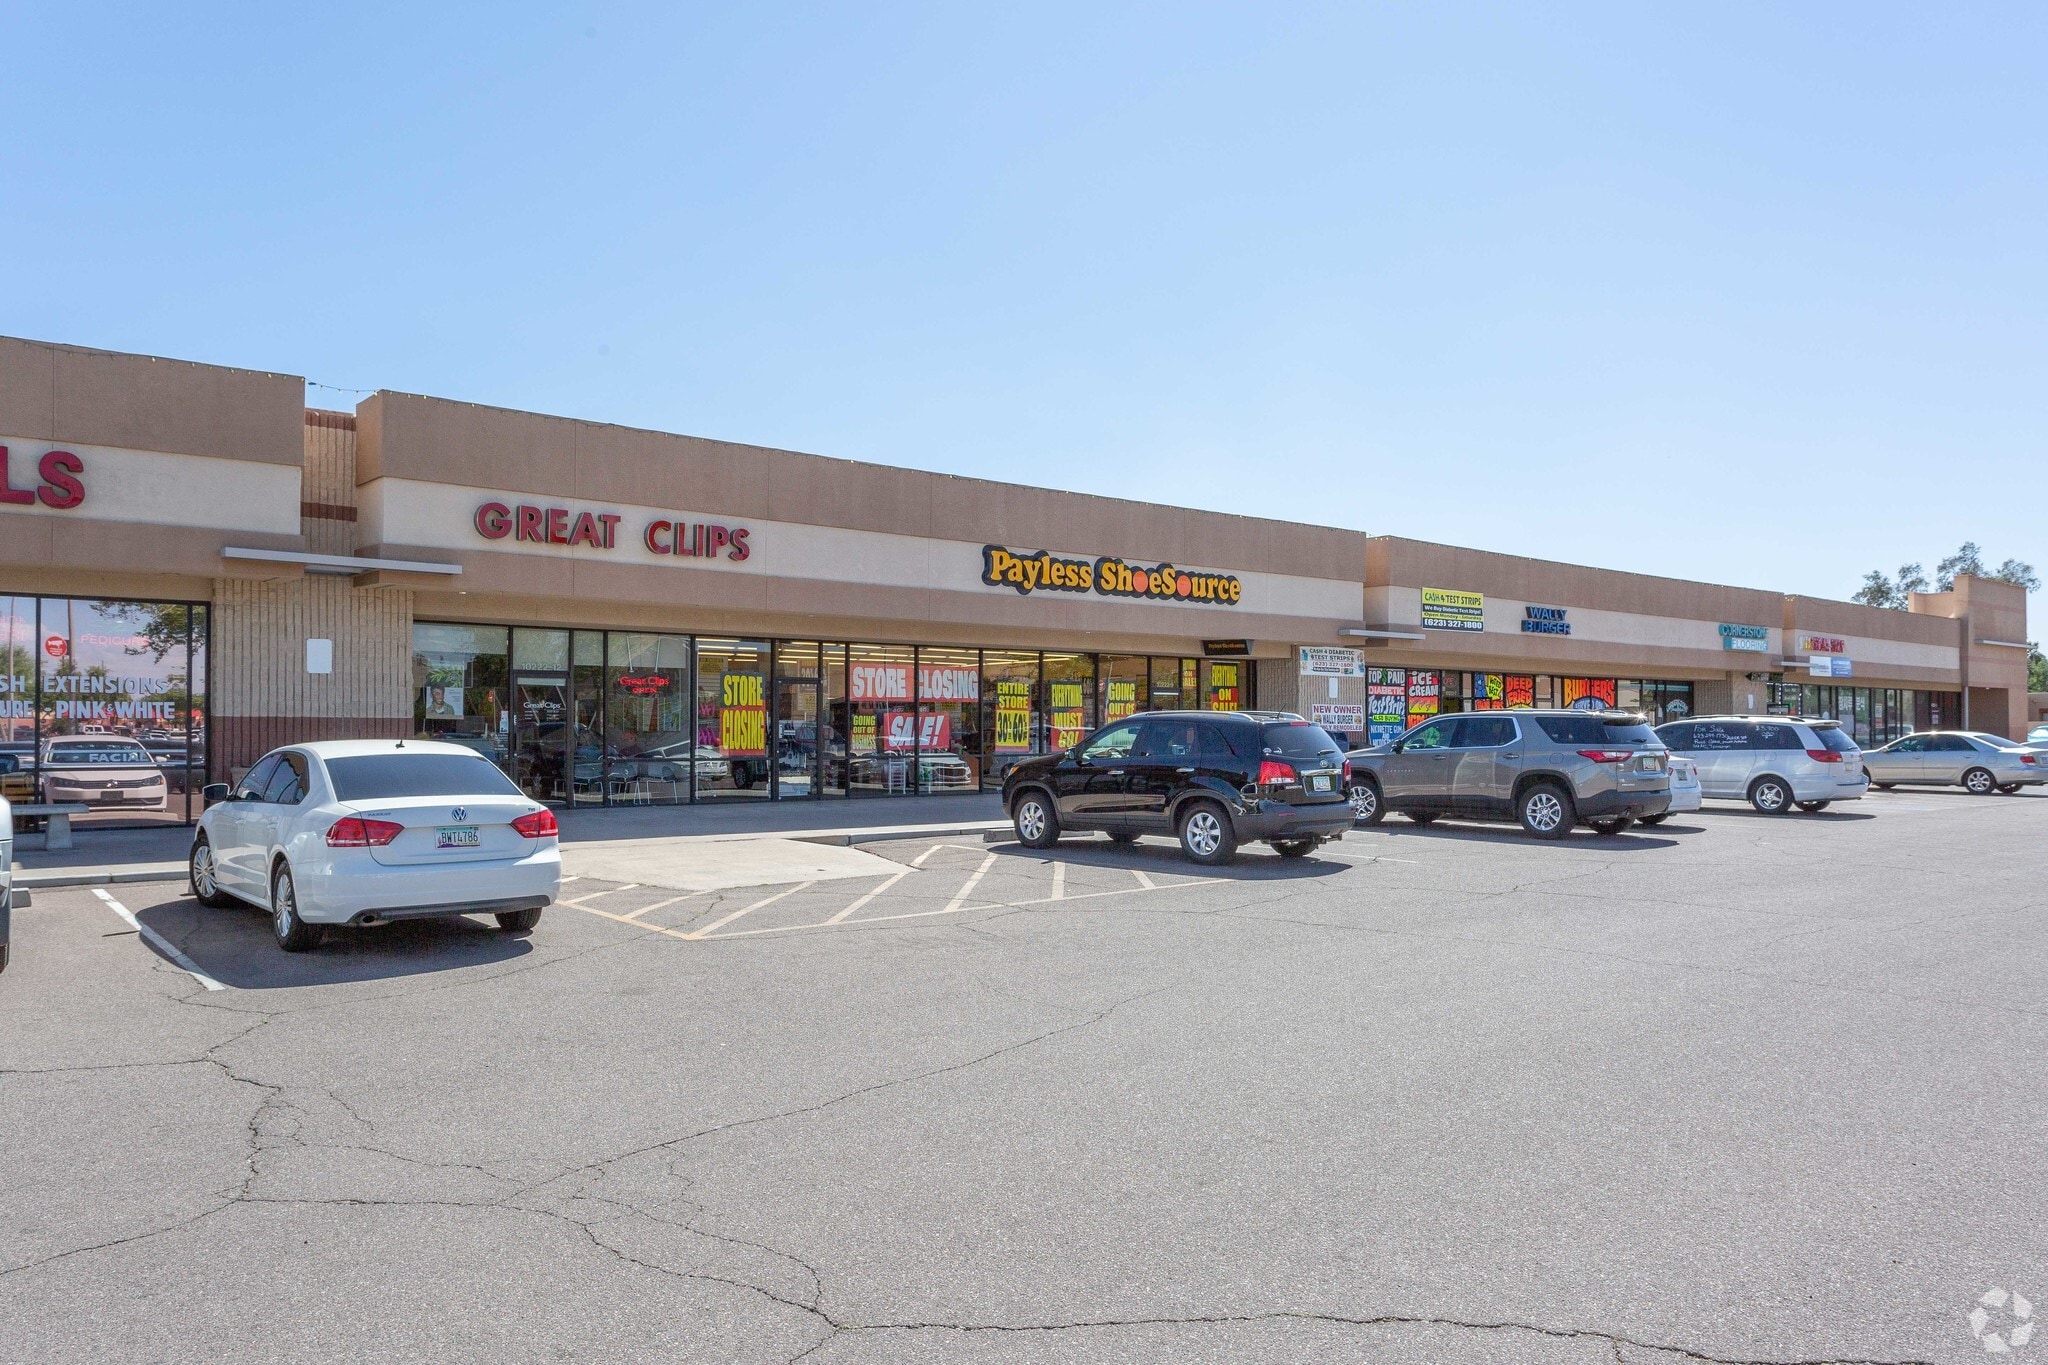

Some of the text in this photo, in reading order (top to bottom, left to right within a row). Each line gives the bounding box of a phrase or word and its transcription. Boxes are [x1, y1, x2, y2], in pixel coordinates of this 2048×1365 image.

[474, 502, 750, 561] GREAT CLIPS
[988, 548, 1092, 591] Payless
[1440, 594, 1445, 602] 4
[1445, 595, 1460, 604] TEST
[1461, 596, 1481, 606] STRIPS
[1527, 606, 1567, 620] WALLY
[1424, 618, 1482, 629] (623) 327-1800
[1523, 620, 1571, 635] BURGER
[1729, 638, 1768, 651] FLOORING
[620, 676, 669, 686] Great Clips
[852, 666, 906, 698] STORE
[1369, 670, 1382, 683] TOP
[1388, 670, 1405, 684] PAID
[1506, 676, 1533, 692] DEEP
[43, 675, 168, 694] EXTENSIONS
[723, 674, 763, 706] STORE
[997, 682, 1029, 695] ENTIRE
[1108, 682, 1136, 701] GOING
[1368, 685, 1405, 695] DIABETIC
[1409, 685, 1438, 697] CREAM
[1218, 688, 1232, 701] ON
[1564, 679, 1615, 708] BURGERS
[999, 695, 1028, 709] STORE
[1109, 702, 1135, 715] OUT OF
[1368, 695, 1385, 714] Test
[56, 700, 107, 719] PINK
[115, 701, 175, 719] WHITE
[1313, 705, 1361, 714] NEW OWNER
[853, 714, 875, 726] GOING
[1054, 712, 1082, 728] MUST
[1322, 714, 1353, 724] WALLY BURGER
[723, 709, 764, 751] CLOSING
[853, 726, 875, 734] OUT OF
[1058, 731, 1079, 748] GO!
[441, 832, 479, 844] BWT4786
